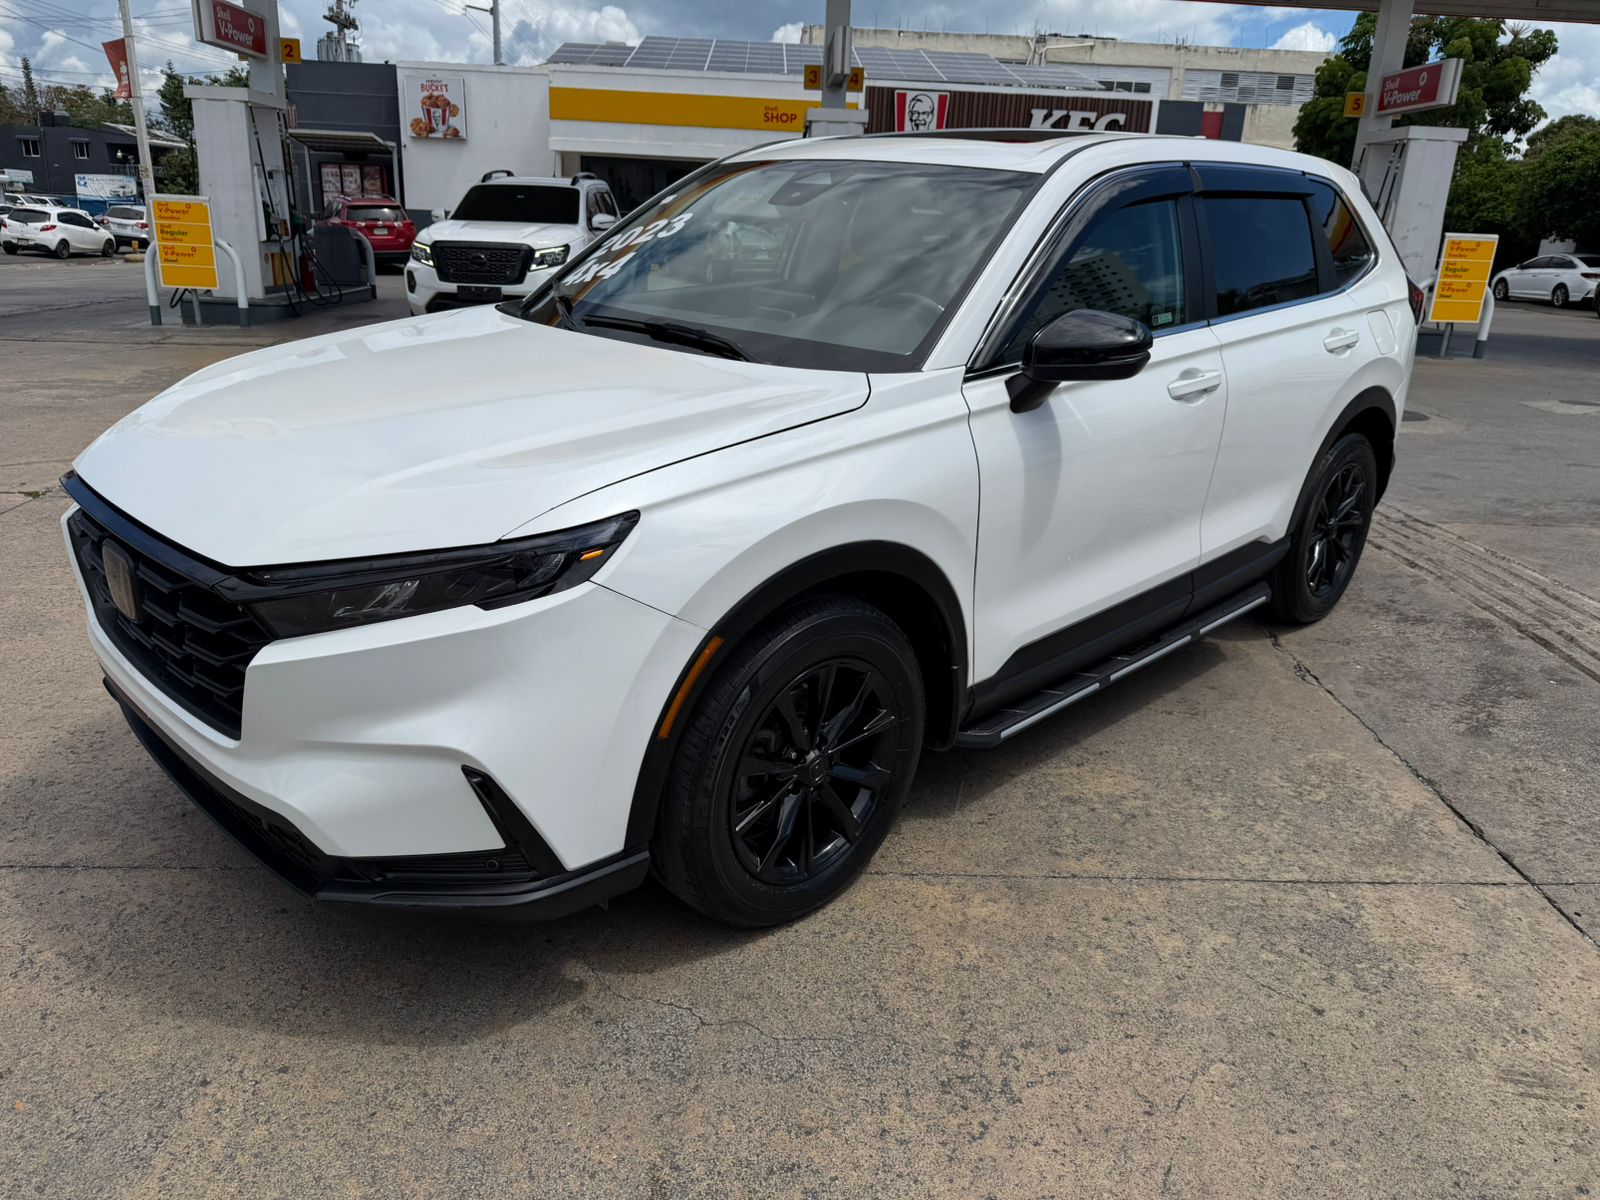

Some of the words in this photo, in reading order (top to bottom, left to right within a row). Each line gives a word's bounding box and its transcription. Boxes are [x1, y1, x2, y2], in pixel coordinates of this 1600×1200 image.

[216, 6, 231, 21] Shell
[218, 20, 254, 46] V-Power
[284, 44, 293, 57] 2
[809, 70, 818, 84] 3
[850, 72, 859, 85] 4
[421, 83, 448, 93] BUCKET
[1384, 78, 1400, 91] Shell
[1384, 89, 1421, 106] V-Power
[1352, 98, 1361, 111] 5
[763, 112, 797, 124] SHOP
[157, 207, 190, 215] V-Power
[160, 229, 188, 237] Regular
[585, 213, 693, 261] 2023
[163, 250, 195, 258] V-Power
